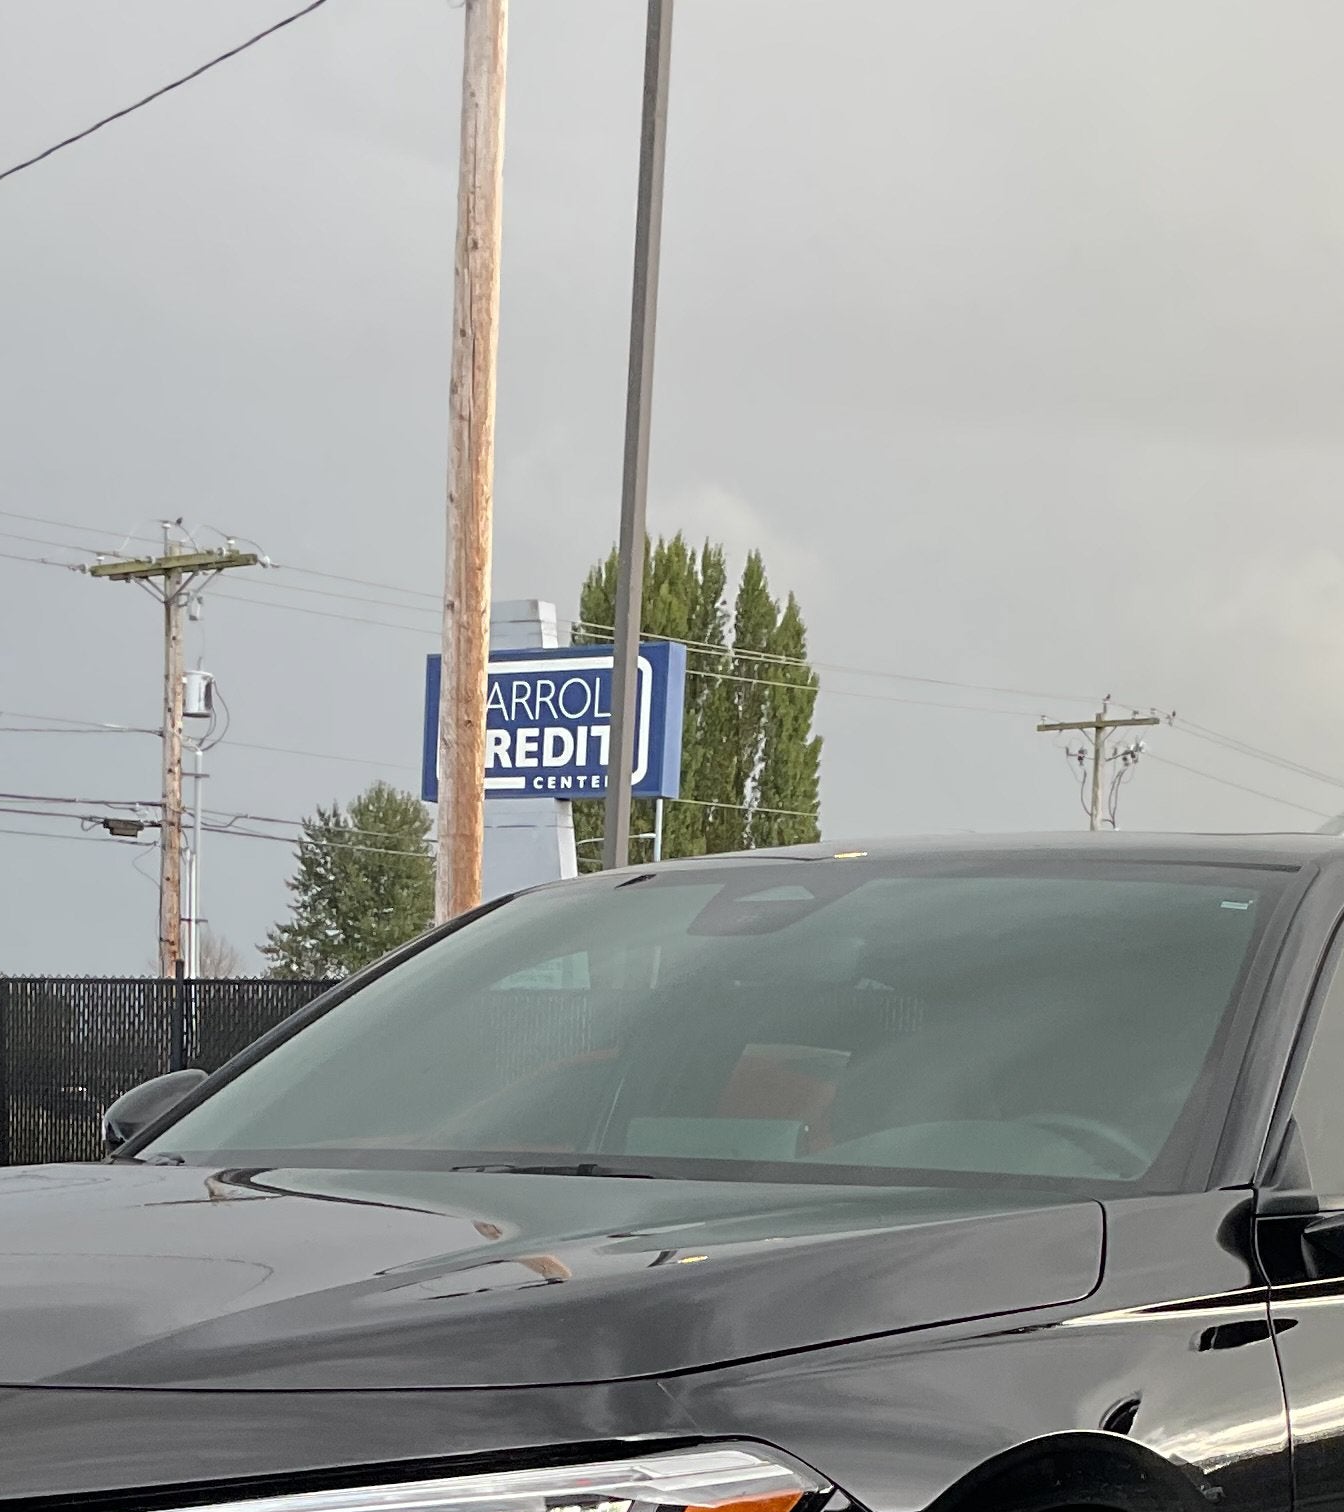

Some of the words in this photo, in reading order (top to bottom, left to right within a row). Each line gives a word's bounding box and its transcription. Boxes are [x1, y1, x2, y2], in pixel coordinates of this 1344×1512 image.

[485, 677, 612, 721] ARROL
[484, 725, 611, 769] REDIT
[533, 775, 609, 789] CENTE
